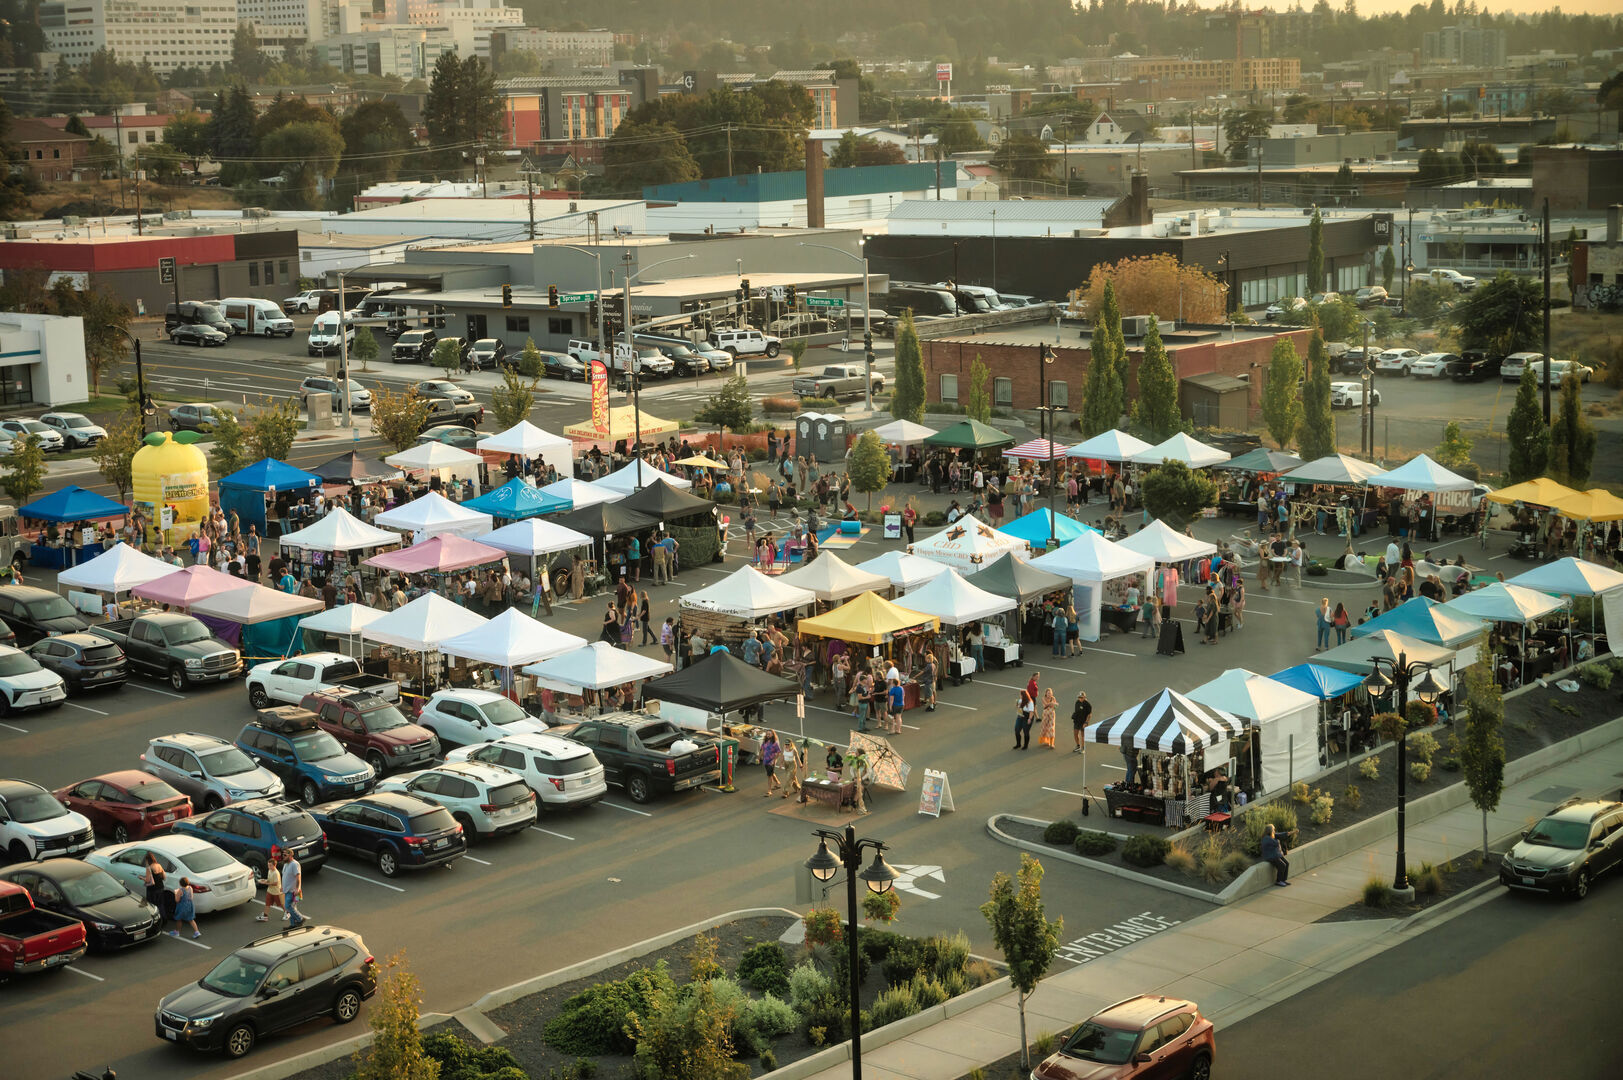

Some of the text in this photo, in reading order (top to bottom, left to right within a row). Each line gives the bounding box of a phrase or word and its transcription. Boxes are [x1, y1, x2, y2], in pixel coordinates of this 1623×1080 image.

[593, 381, 602, 426] TACOS
[1436, 490, 1471, 507] TRICK
[917, 547, 934, 557] Happy
[935, 550, 953, 558] Moose
[933, 540, 961, 550] CBD
[1054, 911, 1182, 964] ENTRANCE
